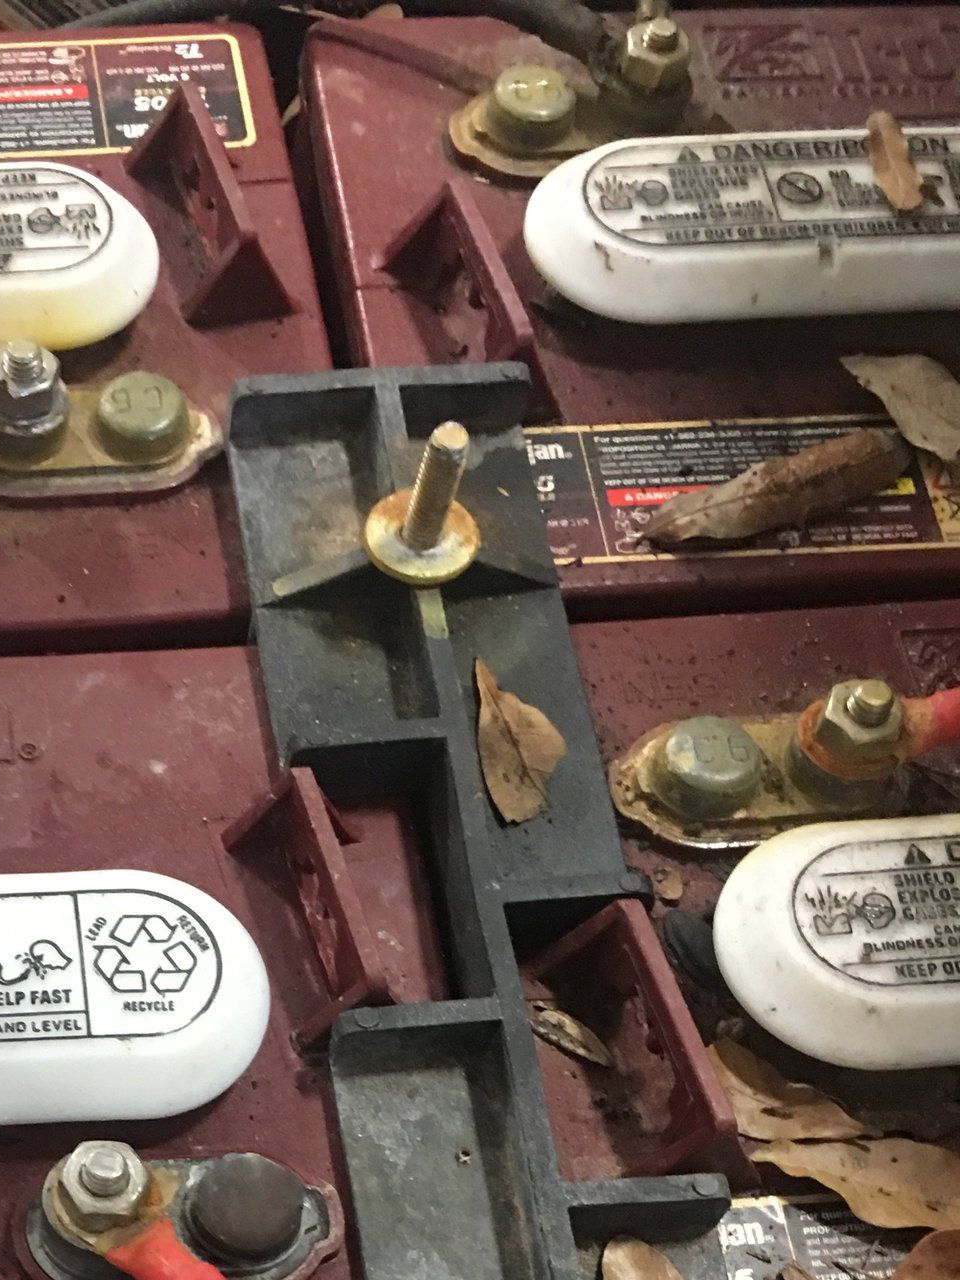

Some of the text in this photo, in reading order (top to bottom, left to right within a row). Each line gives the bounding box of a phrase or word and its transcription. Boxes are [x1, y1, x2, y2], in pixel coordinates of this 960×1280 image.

[84, 914, 109, 942] LEAD
[176, 914, 210, 954] RETURN
[30, 989, 73, 1006] FAST
[121, 999, 176, 1013] RECYCLE
[31, 1018, 84, 1033] LEVEL
